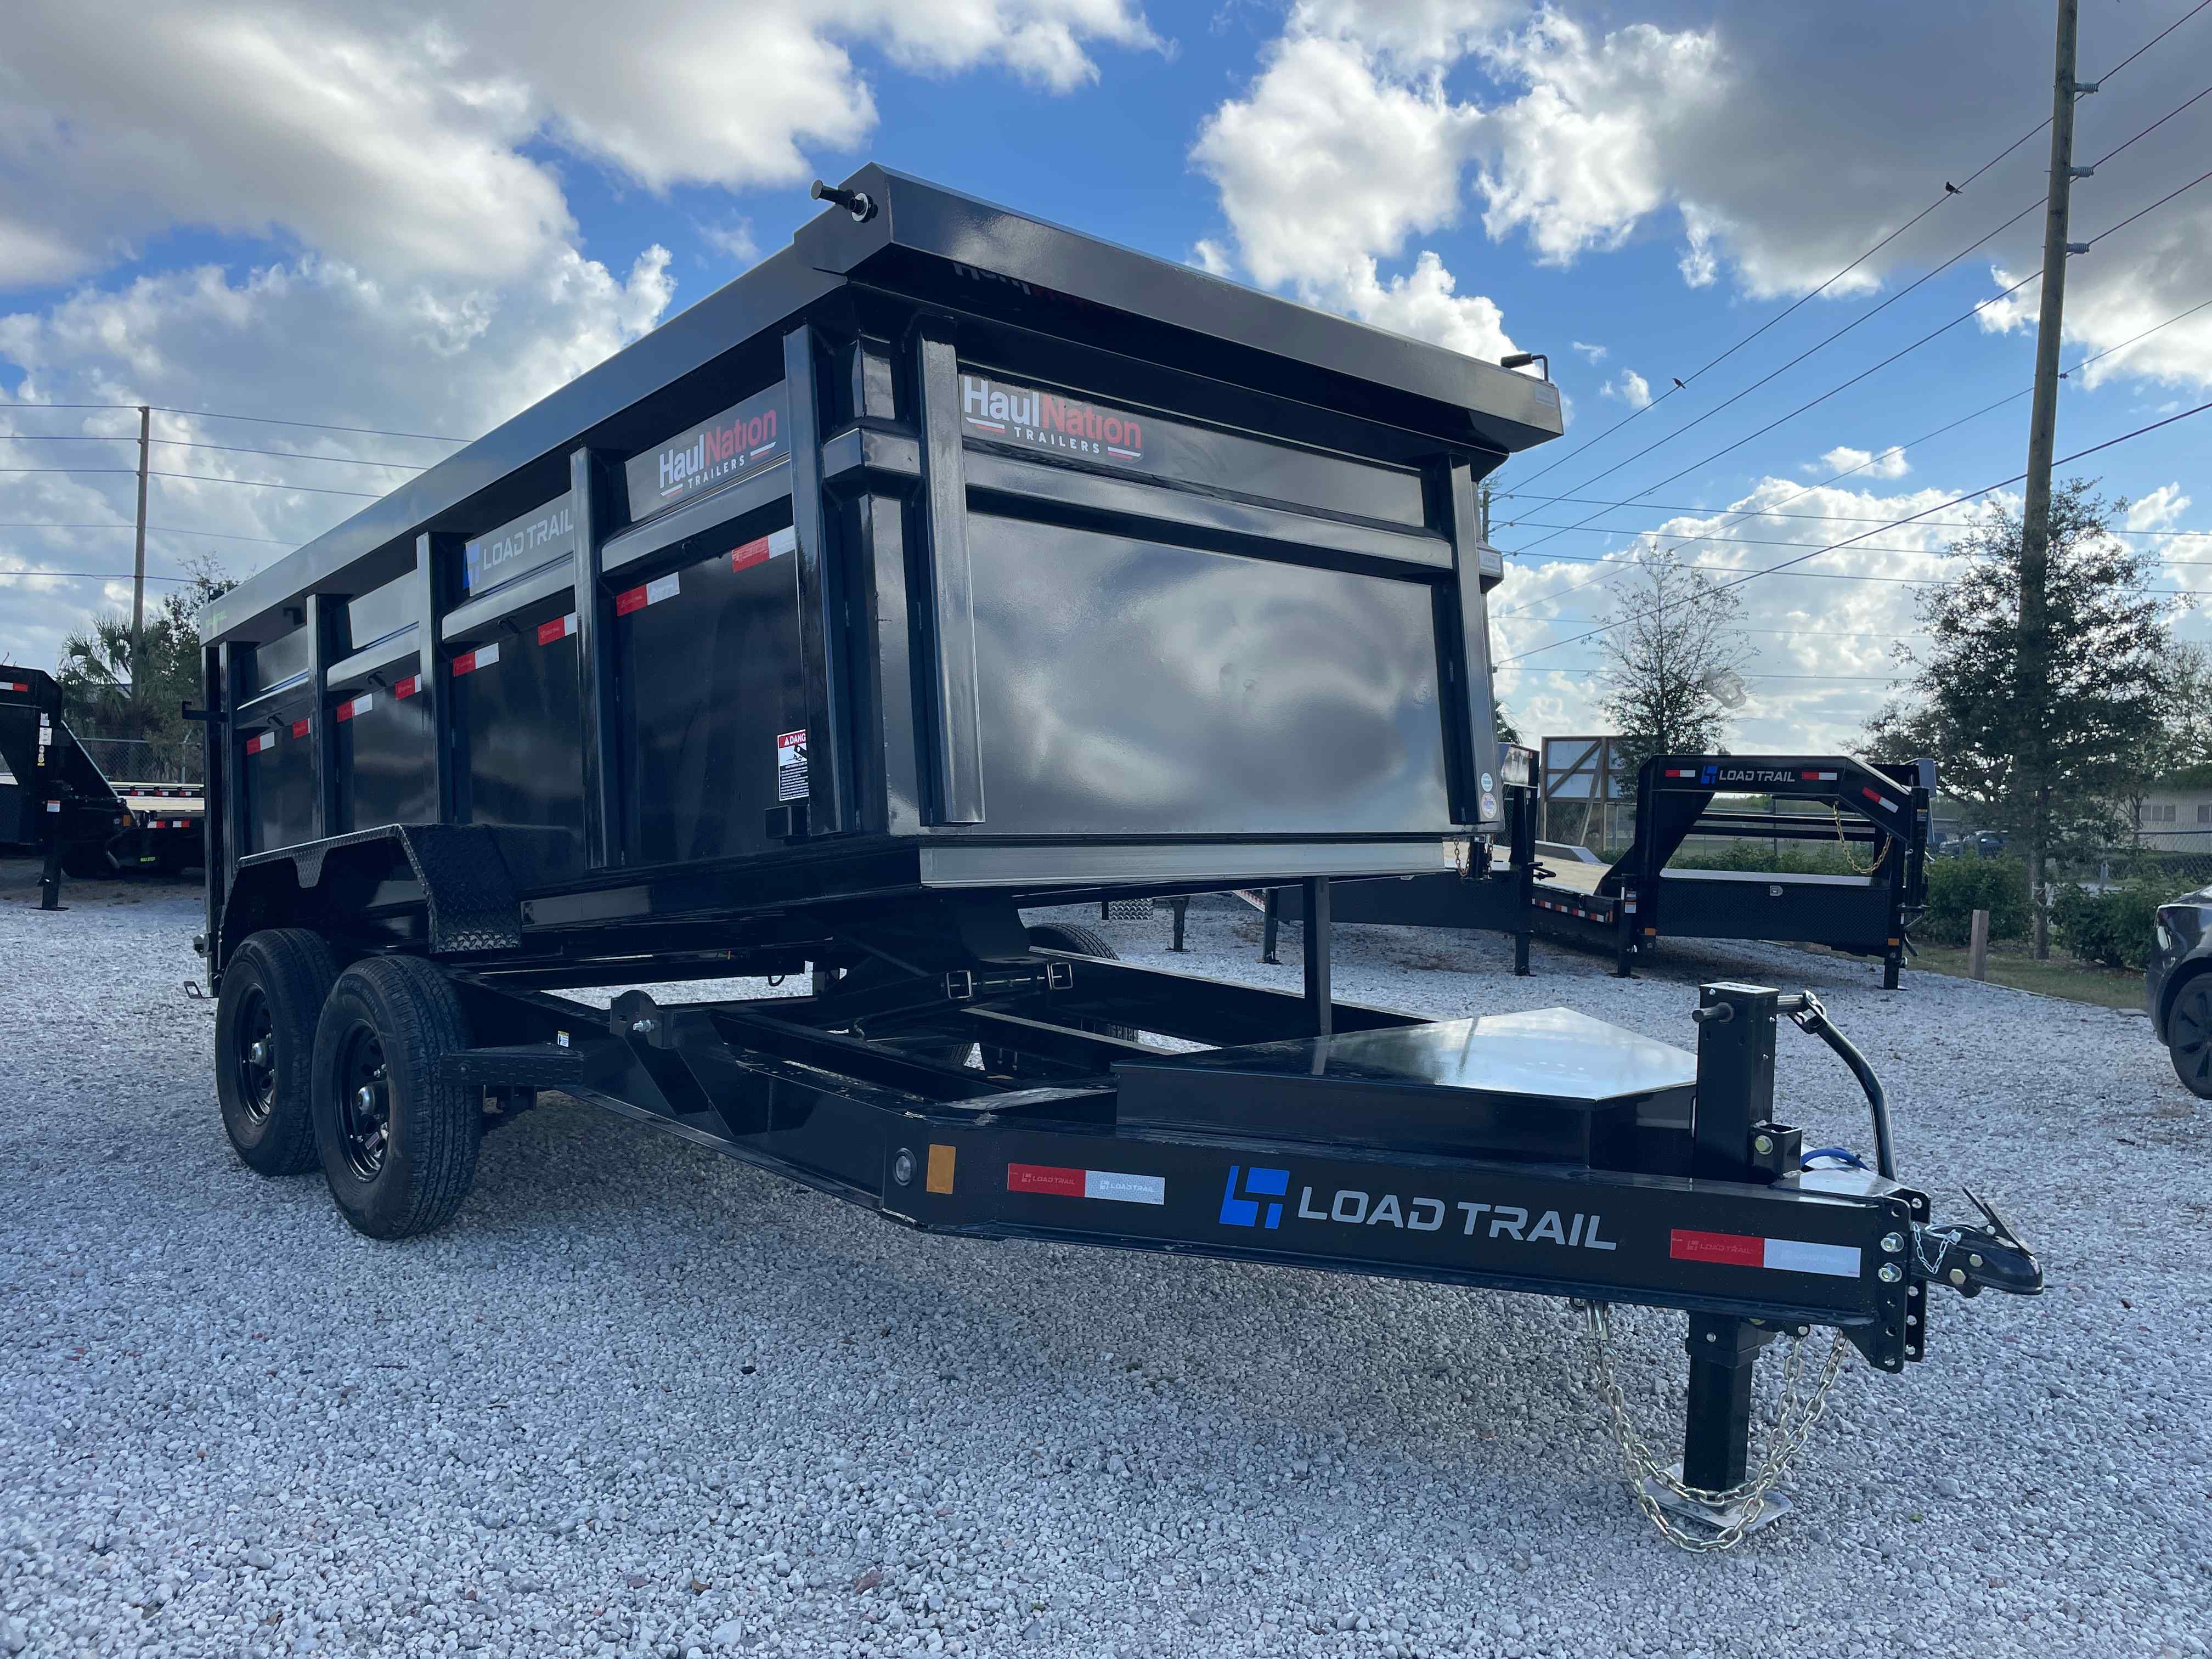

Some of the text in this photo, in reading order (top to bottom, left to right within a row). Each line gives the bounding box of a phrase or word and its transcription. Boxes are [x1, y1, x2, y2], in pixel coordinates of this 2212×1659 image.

[964, 376, 1142, 449] HaulNation
[659, 409, 776, 489] HaulNation
[1014, 426, 1099, 454] TRAILERS
[688, 454, 744, 489] TRAILERS
[483, 509, 573, 571] LOAD TRAIL
[1719, 770, 1796, 782] LOAD TRAIL
[1110, 1182, 1133, 1190] LOAD
[1298, 1186, 1617, 1250] LOAD TRAIL
[1700, 1243, 1752, 1255] LOAD TRAIL
